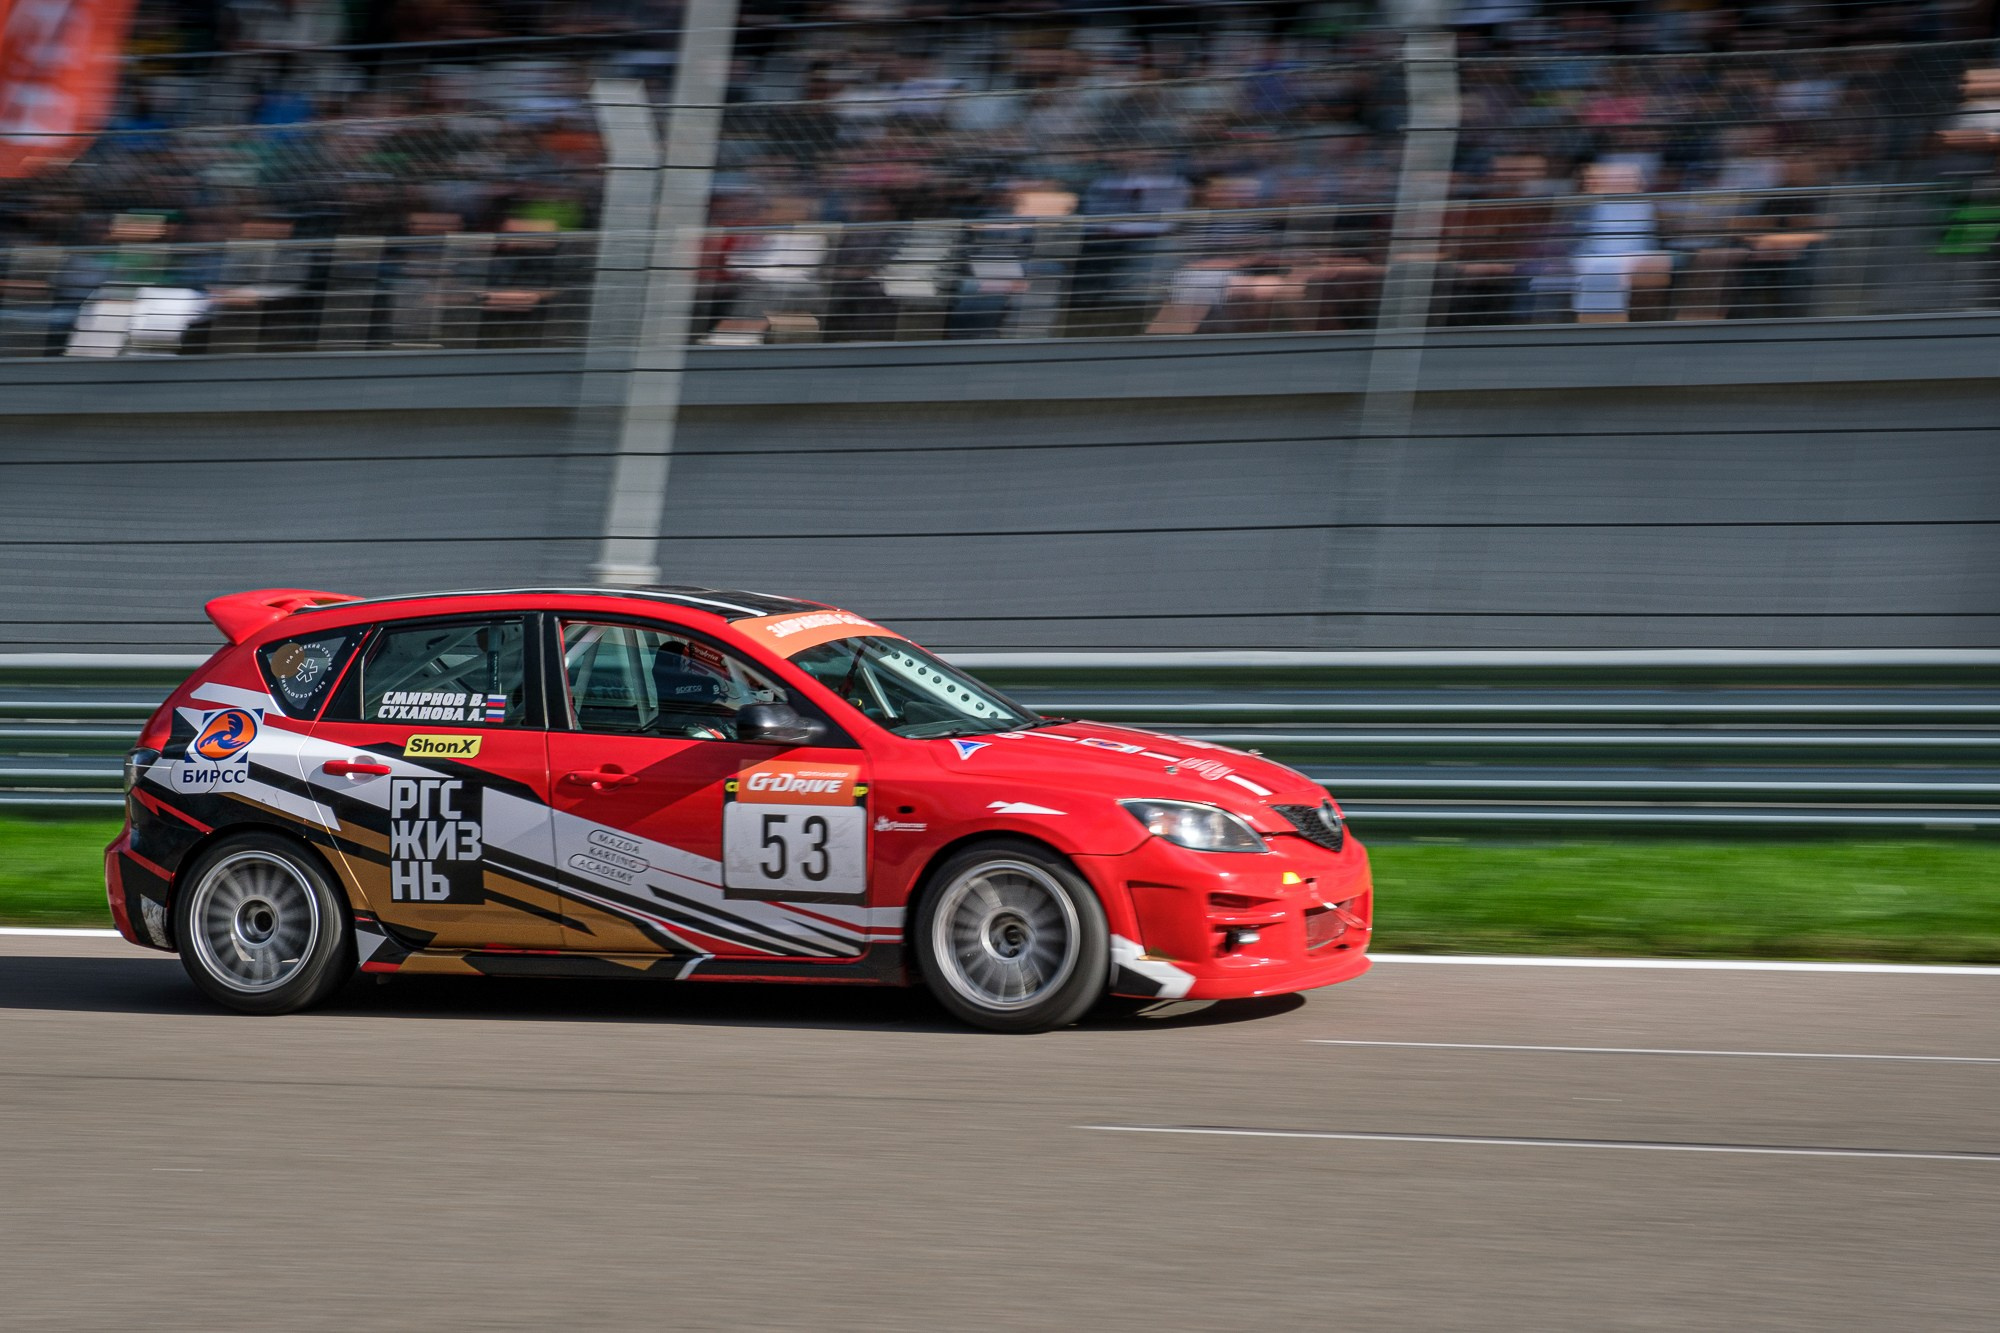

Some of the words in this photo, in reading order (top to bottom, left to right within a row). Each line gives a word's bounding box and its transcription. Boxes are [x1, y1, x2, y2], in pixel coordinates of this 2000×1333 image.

[381, 691, 467, 706] СМИРНОВ
[469, 693, 487, 707] В.
[377, 706, 465, 721] СУХАНОВА
[467, 708, 485, 722] А.
[409, 738, 477, 753] ShonX
[182, 769, 246, 783] БИРСС
[391, 779, 463, 819] РГС
[391, 820, 482, 861] ЖИЗ
[598, 834, 641, 855] MAZDA
[761, 813, 830, 882] 53
[587, 846, 638, 869] KARTING
[391, 860, 450, 901] НЬ
[577, 859, 635, 882] ACADEMY
